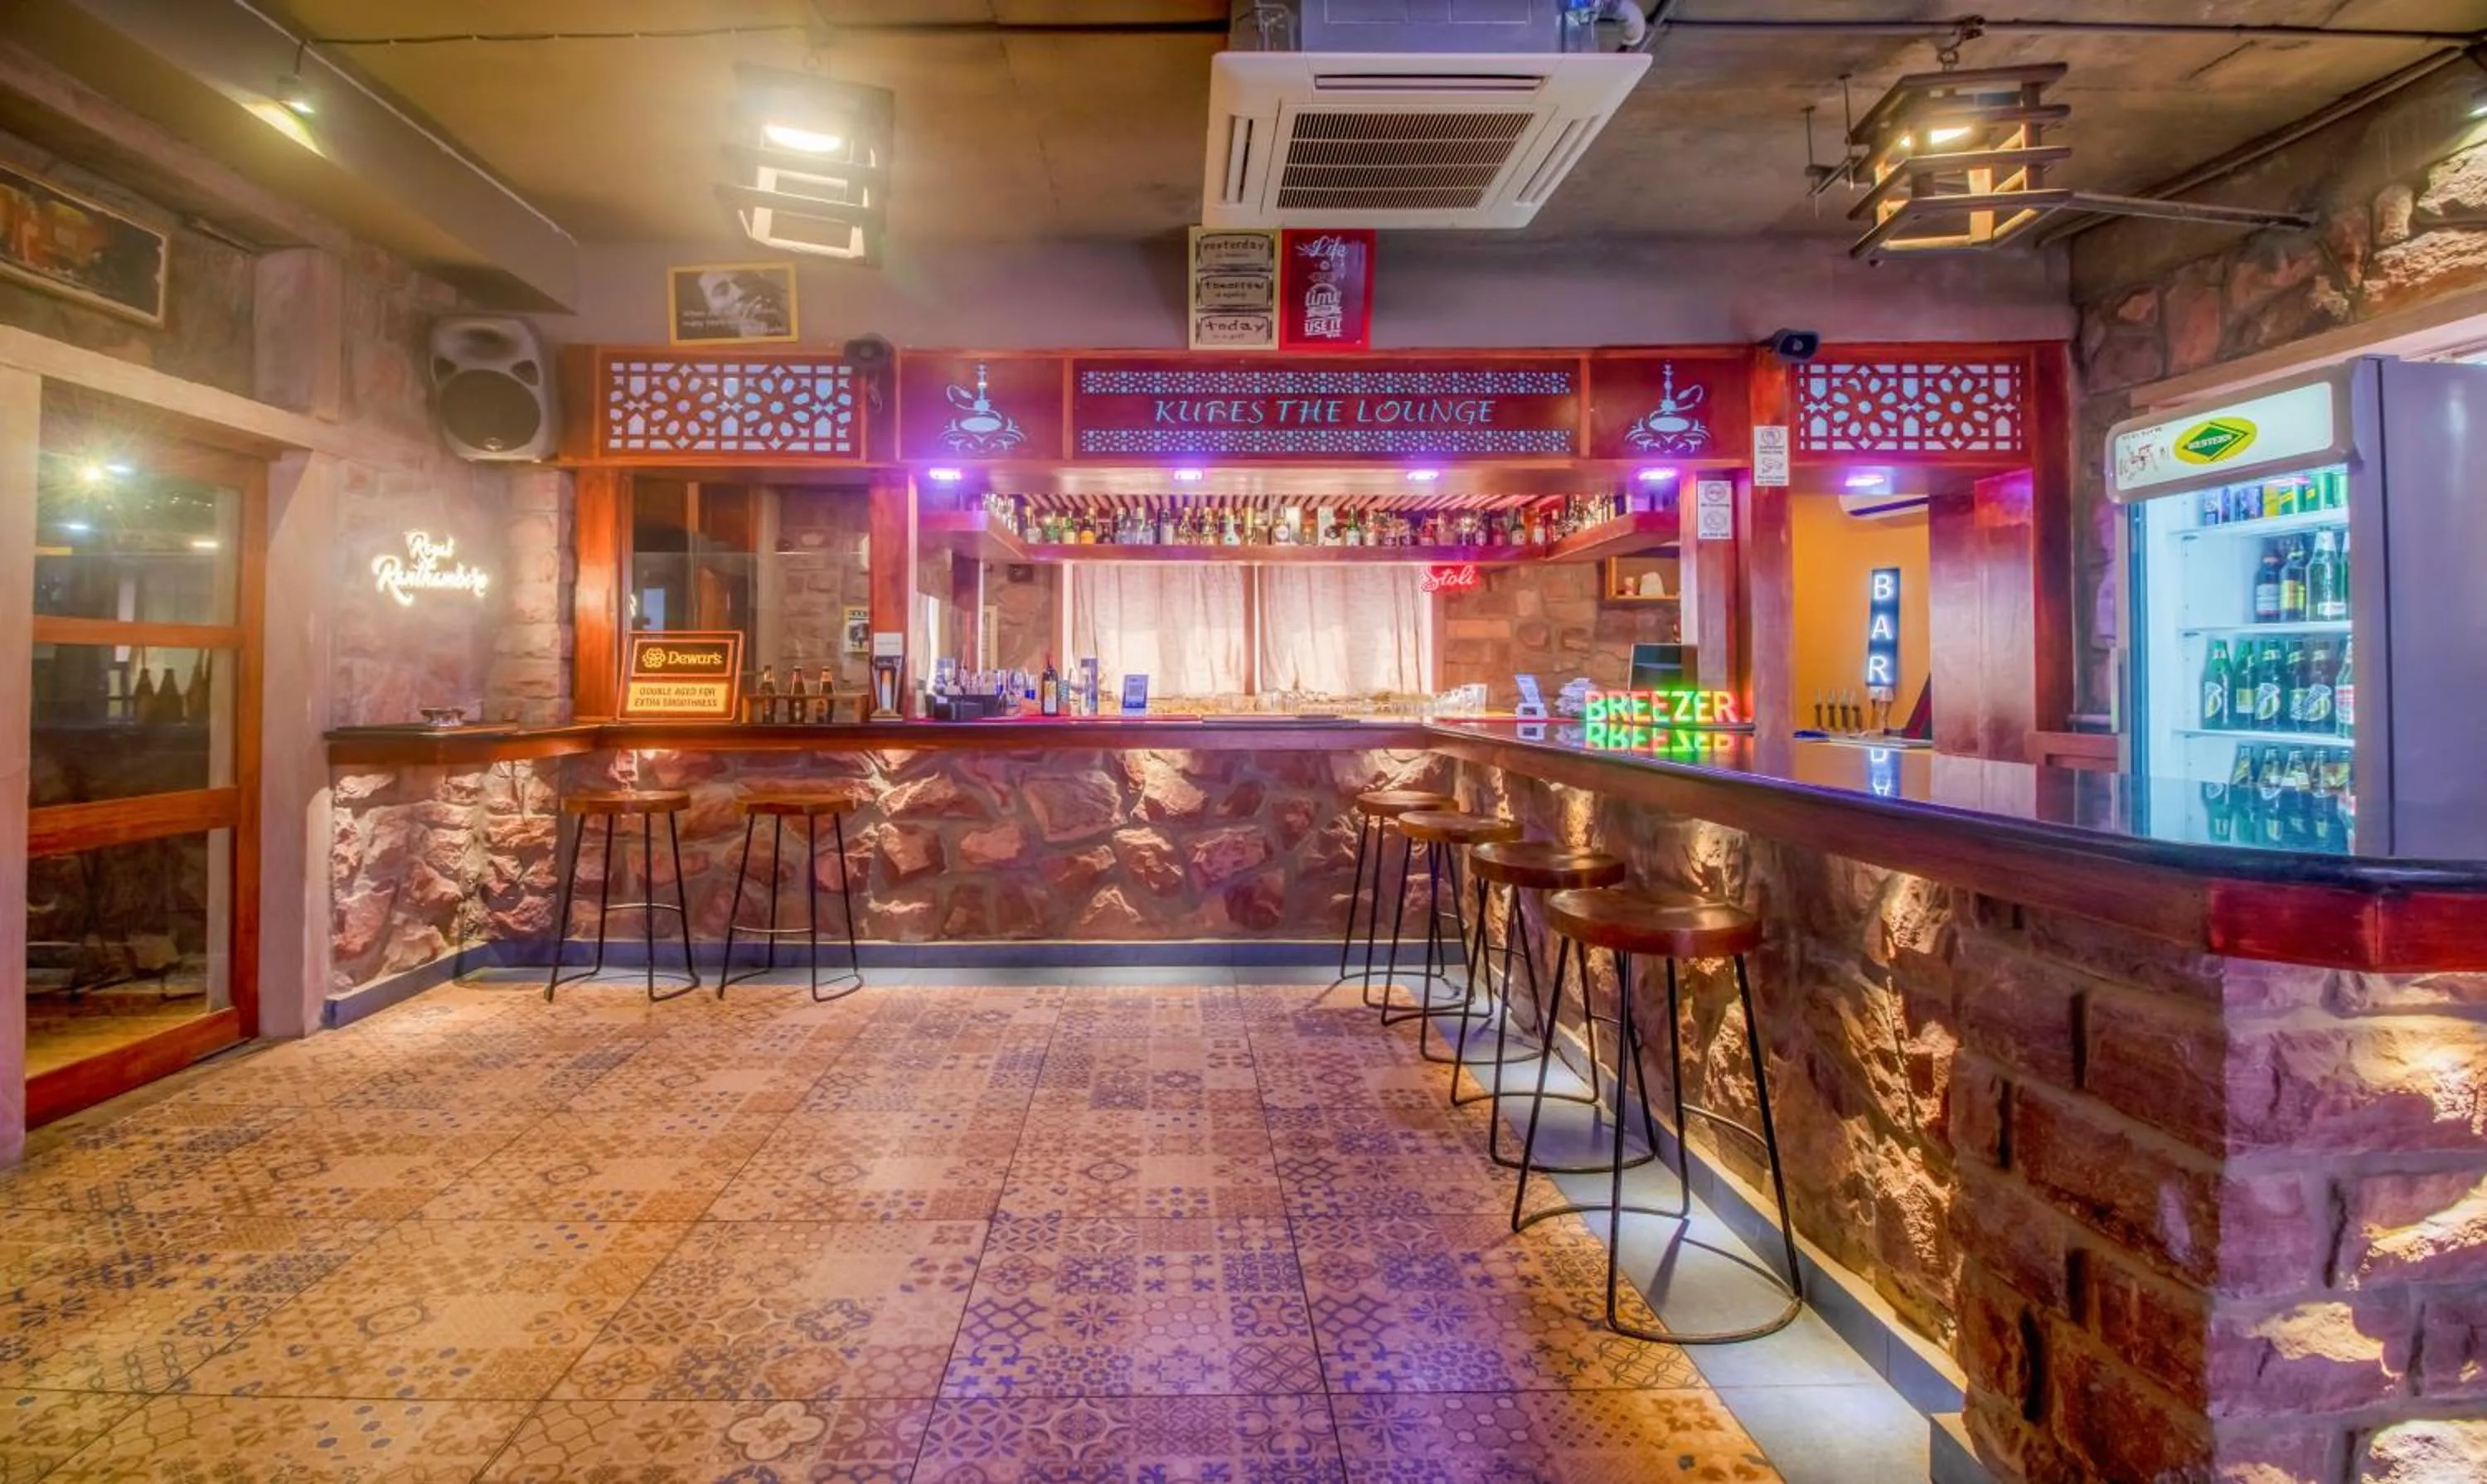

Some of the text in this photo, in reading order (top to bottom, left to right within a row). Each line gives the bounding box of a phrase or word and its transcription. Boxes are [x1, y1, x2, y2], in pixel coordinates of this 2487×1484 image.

[1205, 319, 1265, 332] today
[1275, 400, 1344, 424] THE
[1355, 400, 1497, 425] LOUNGE
[1419, 563, 1476, 594] Stoli
[1867, 573, 1893, 685] BAR
[1585, 689, 1739, 723] BREEZER
